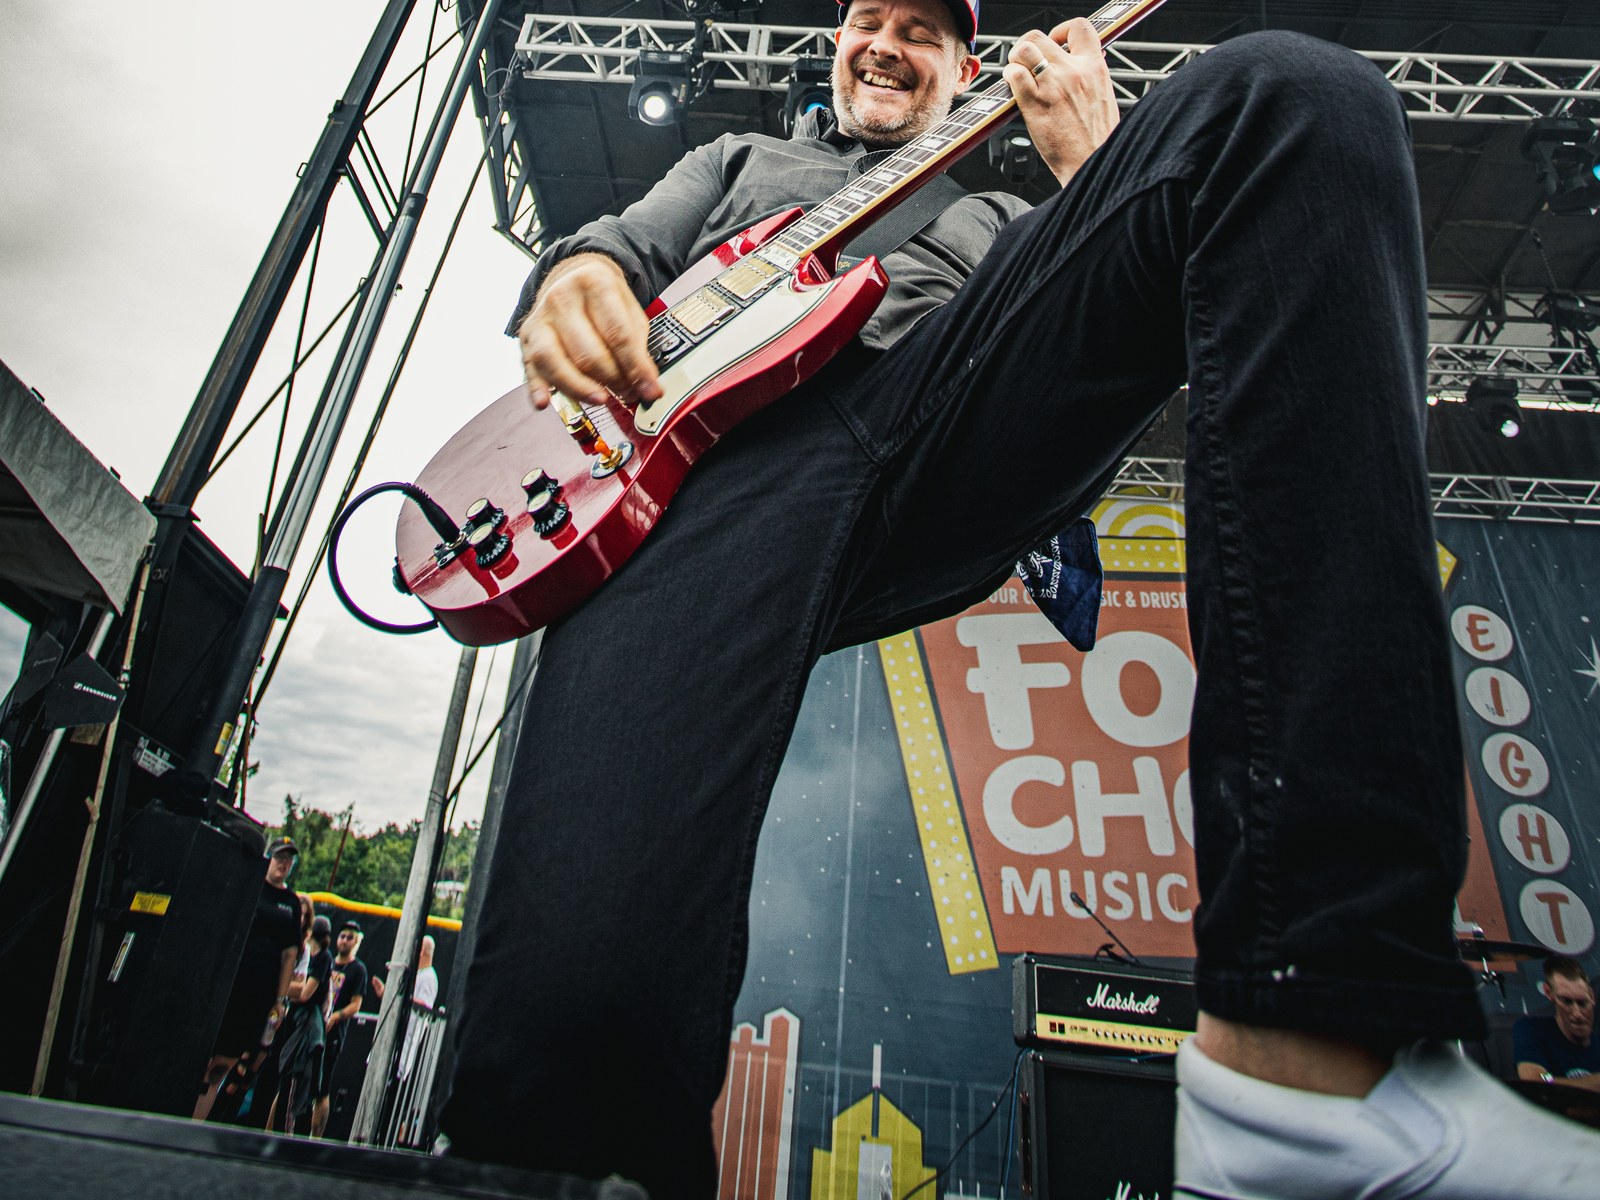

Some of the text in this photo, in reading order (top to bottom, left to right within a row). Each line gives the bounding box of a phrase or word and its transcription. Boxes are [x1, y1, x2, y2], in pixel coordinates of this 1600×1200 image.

[1125, 590, 1137, 608] &
[1465, 612, 1570, 946] EIGHT
[1001, 865, 1193, 924] MUSIC
[1086, 982, 1161, 1014] Marshall
